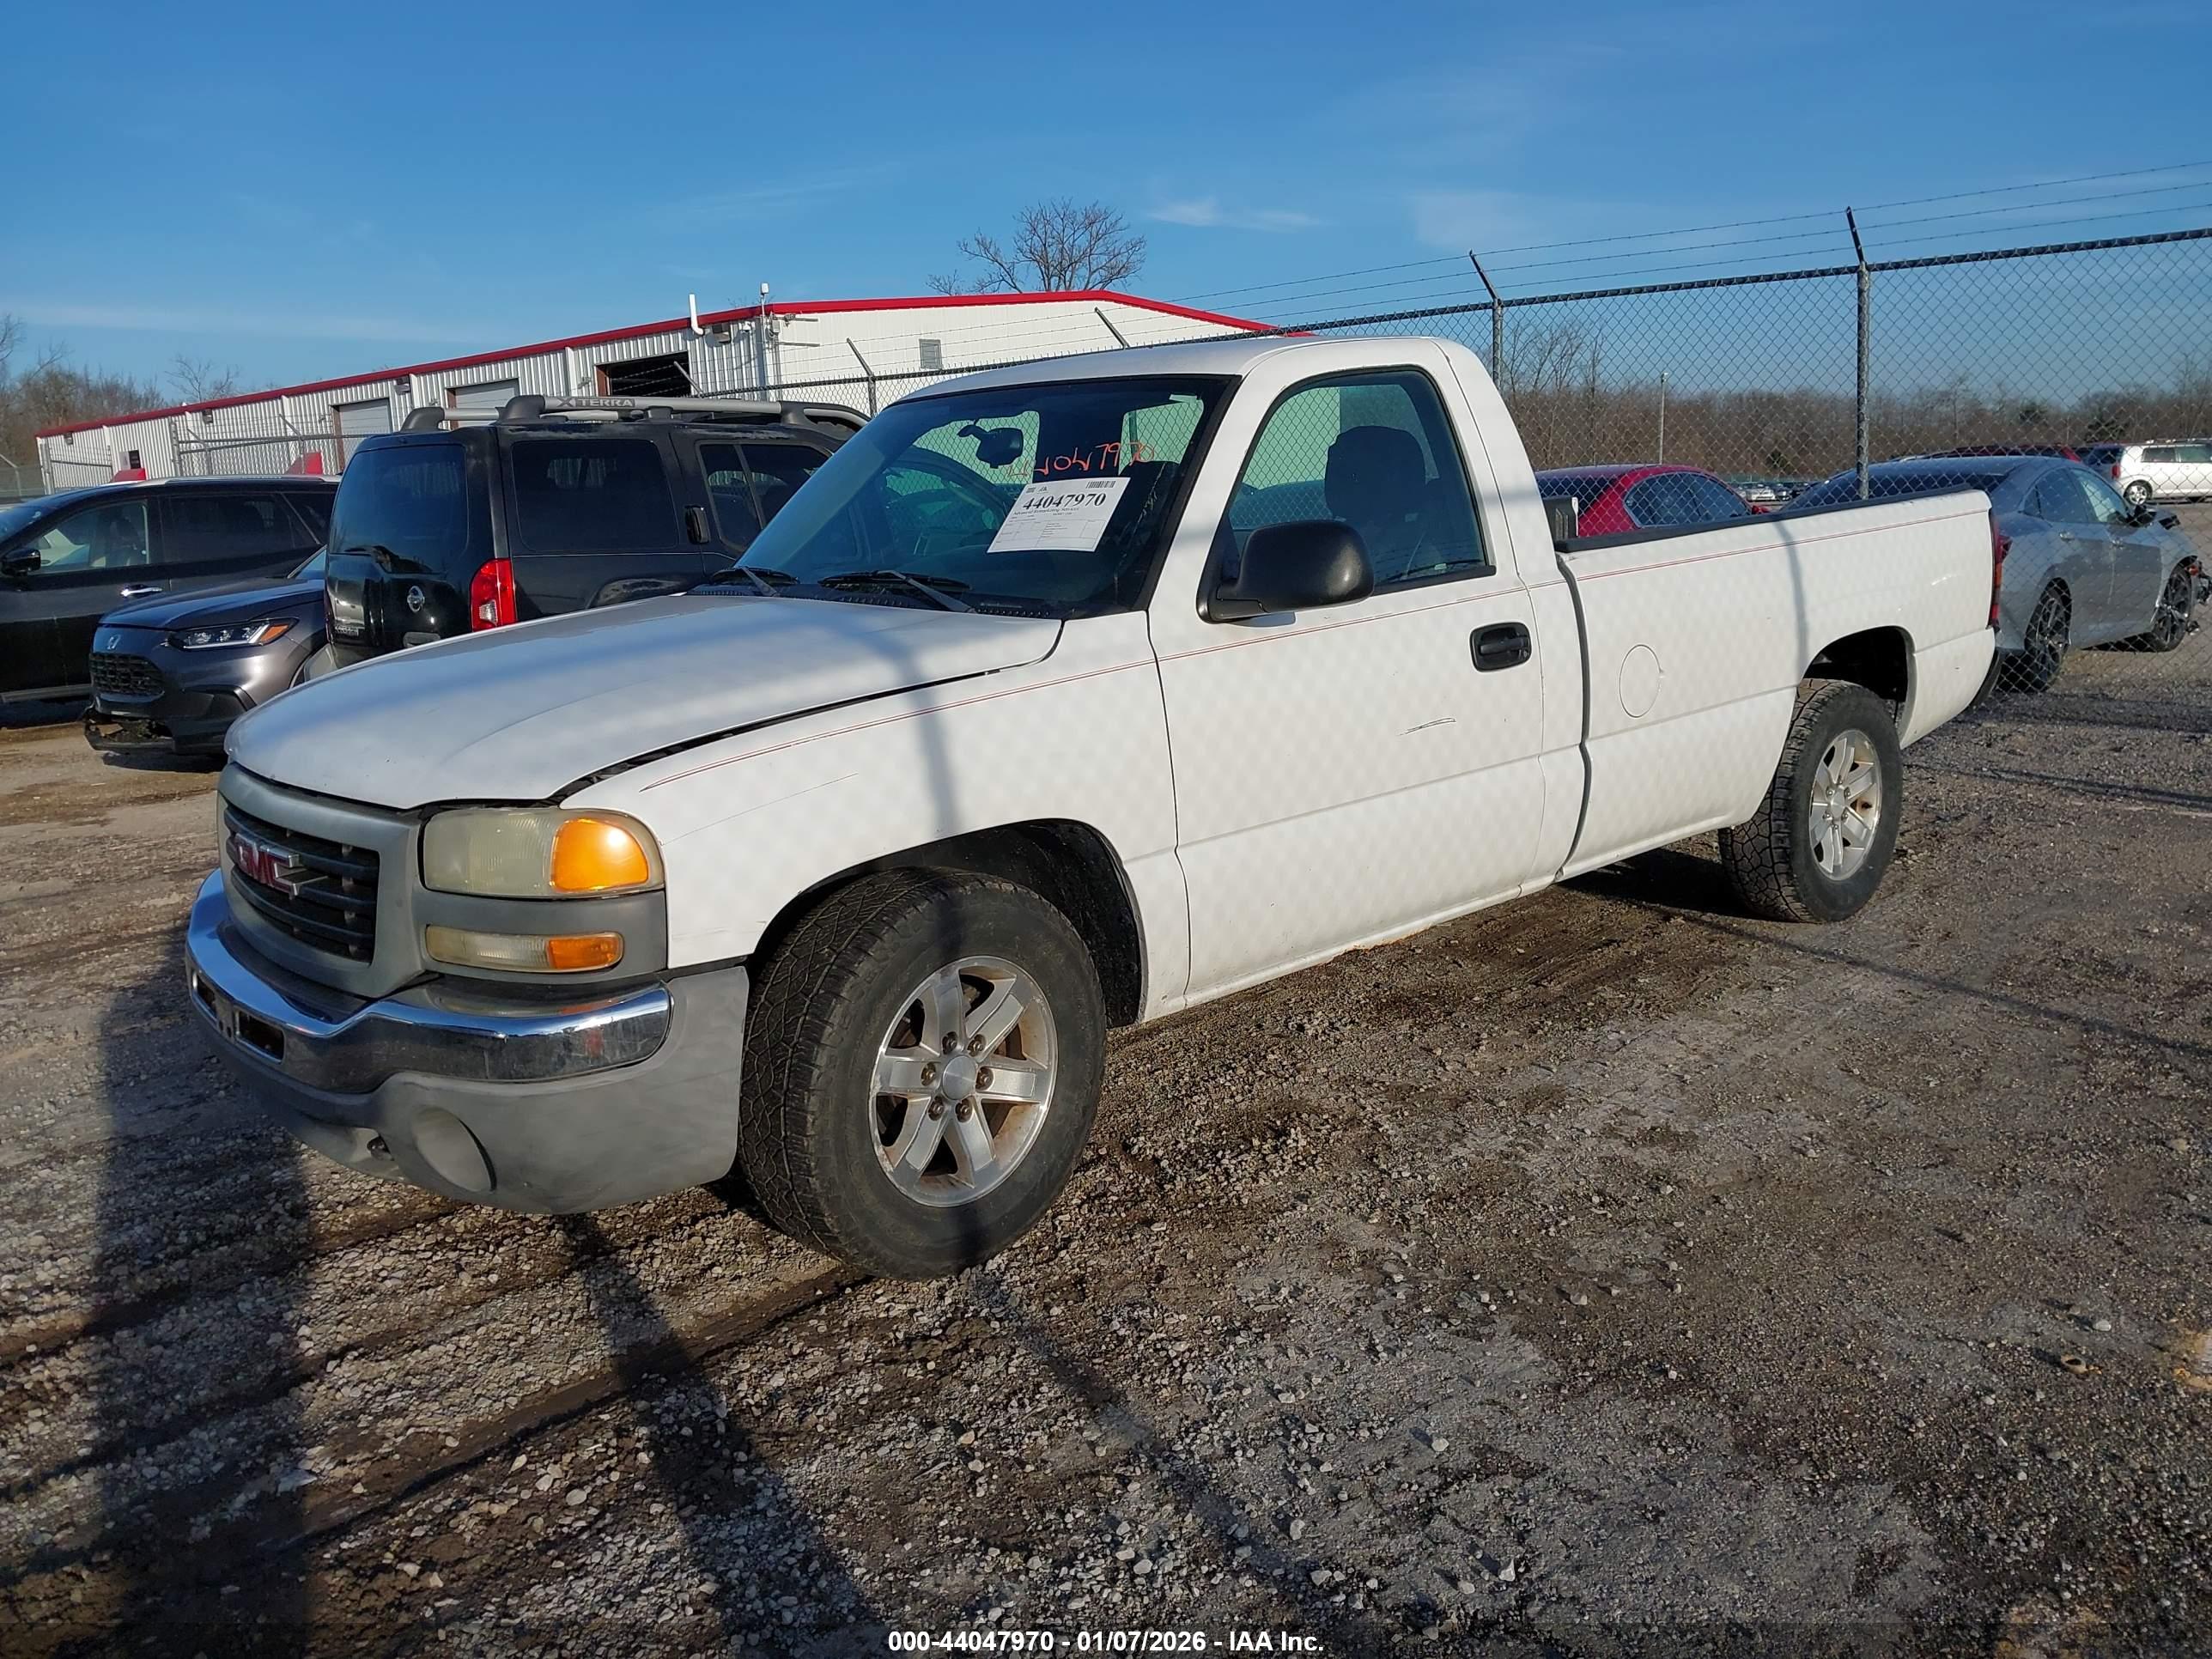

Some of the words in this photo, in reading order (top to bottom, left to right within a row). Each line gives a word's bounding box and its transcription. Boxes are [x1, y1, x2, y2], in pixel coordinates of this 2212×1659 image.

[556, 398, 634, 408] XTERRA
[1023, 493, 1107, 510] 44047970
[234, 833, 299, 896] GMC
